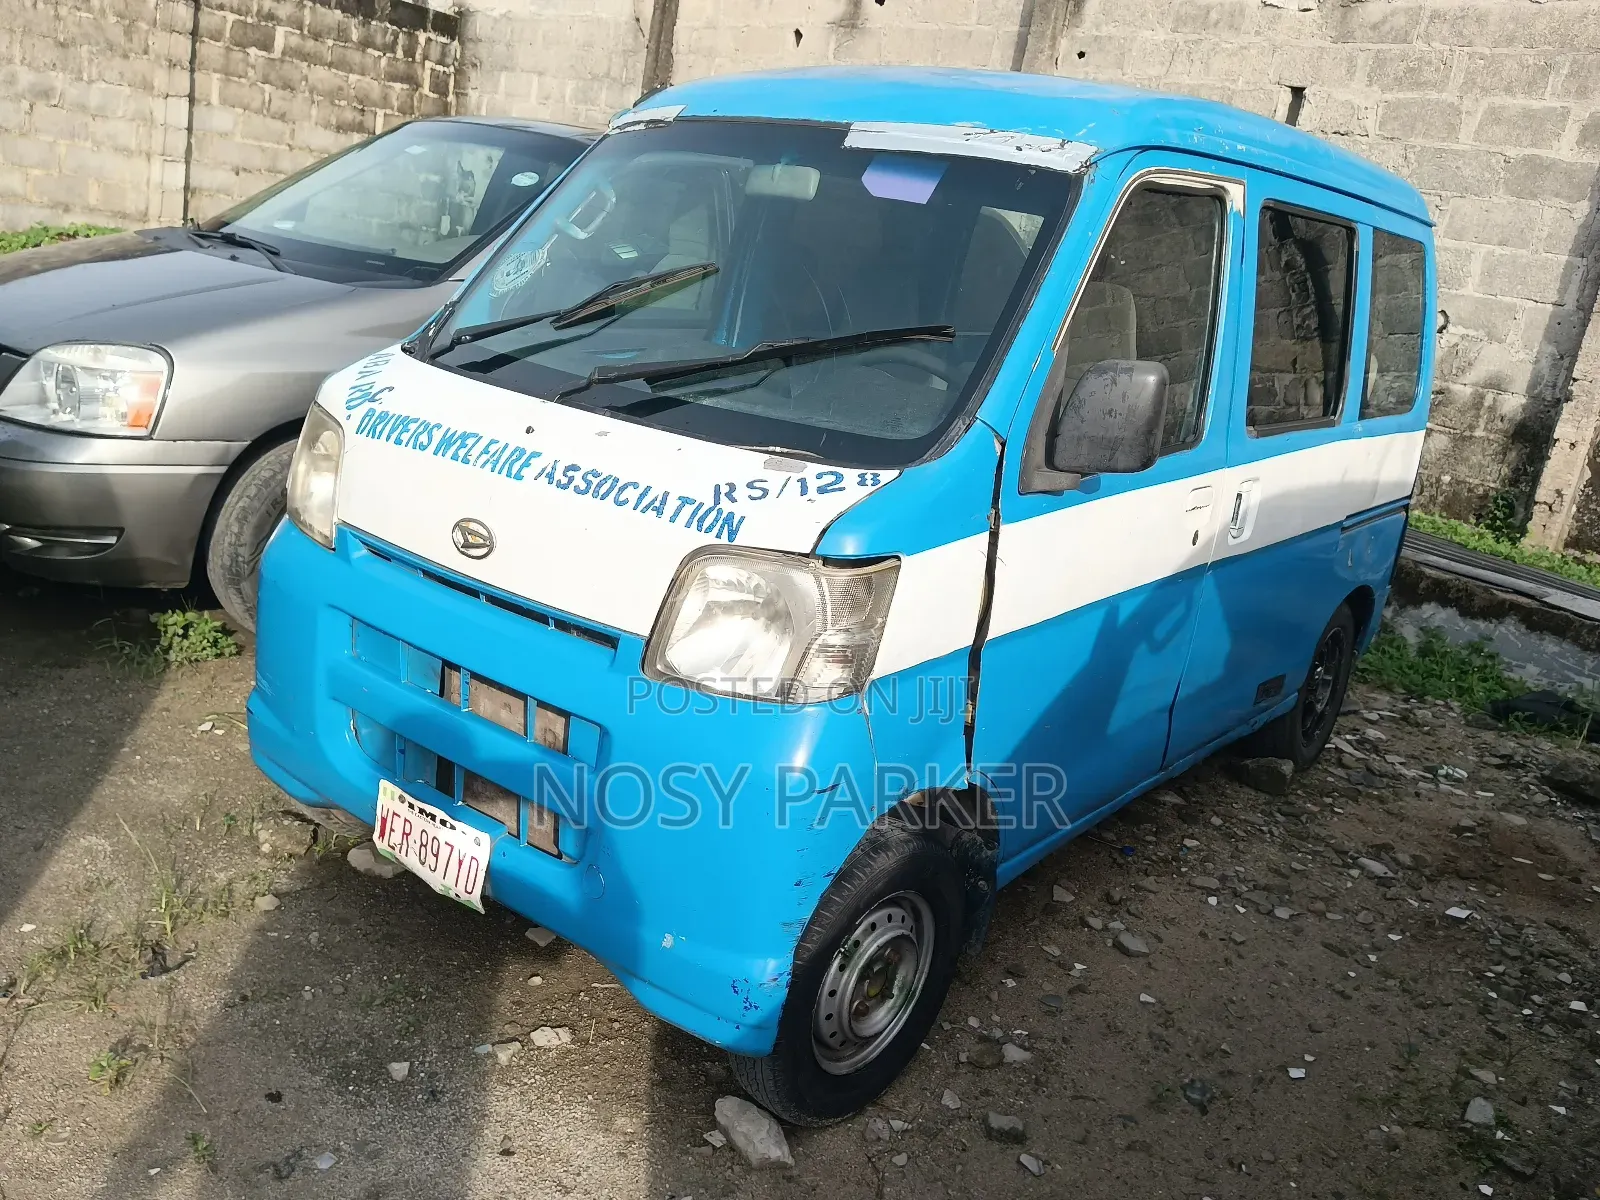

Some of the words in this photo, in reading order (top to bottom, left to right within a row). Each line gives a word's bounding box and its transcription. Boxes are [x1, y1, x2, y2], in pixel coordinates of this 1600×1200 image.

[355, 408, 442, 451] DRIVERS
[433, 427, 542, 481] WELFARE
[534, 460, 745, 543] ASSOCIATION
[378, 803, 480, 895] WER-897YD
